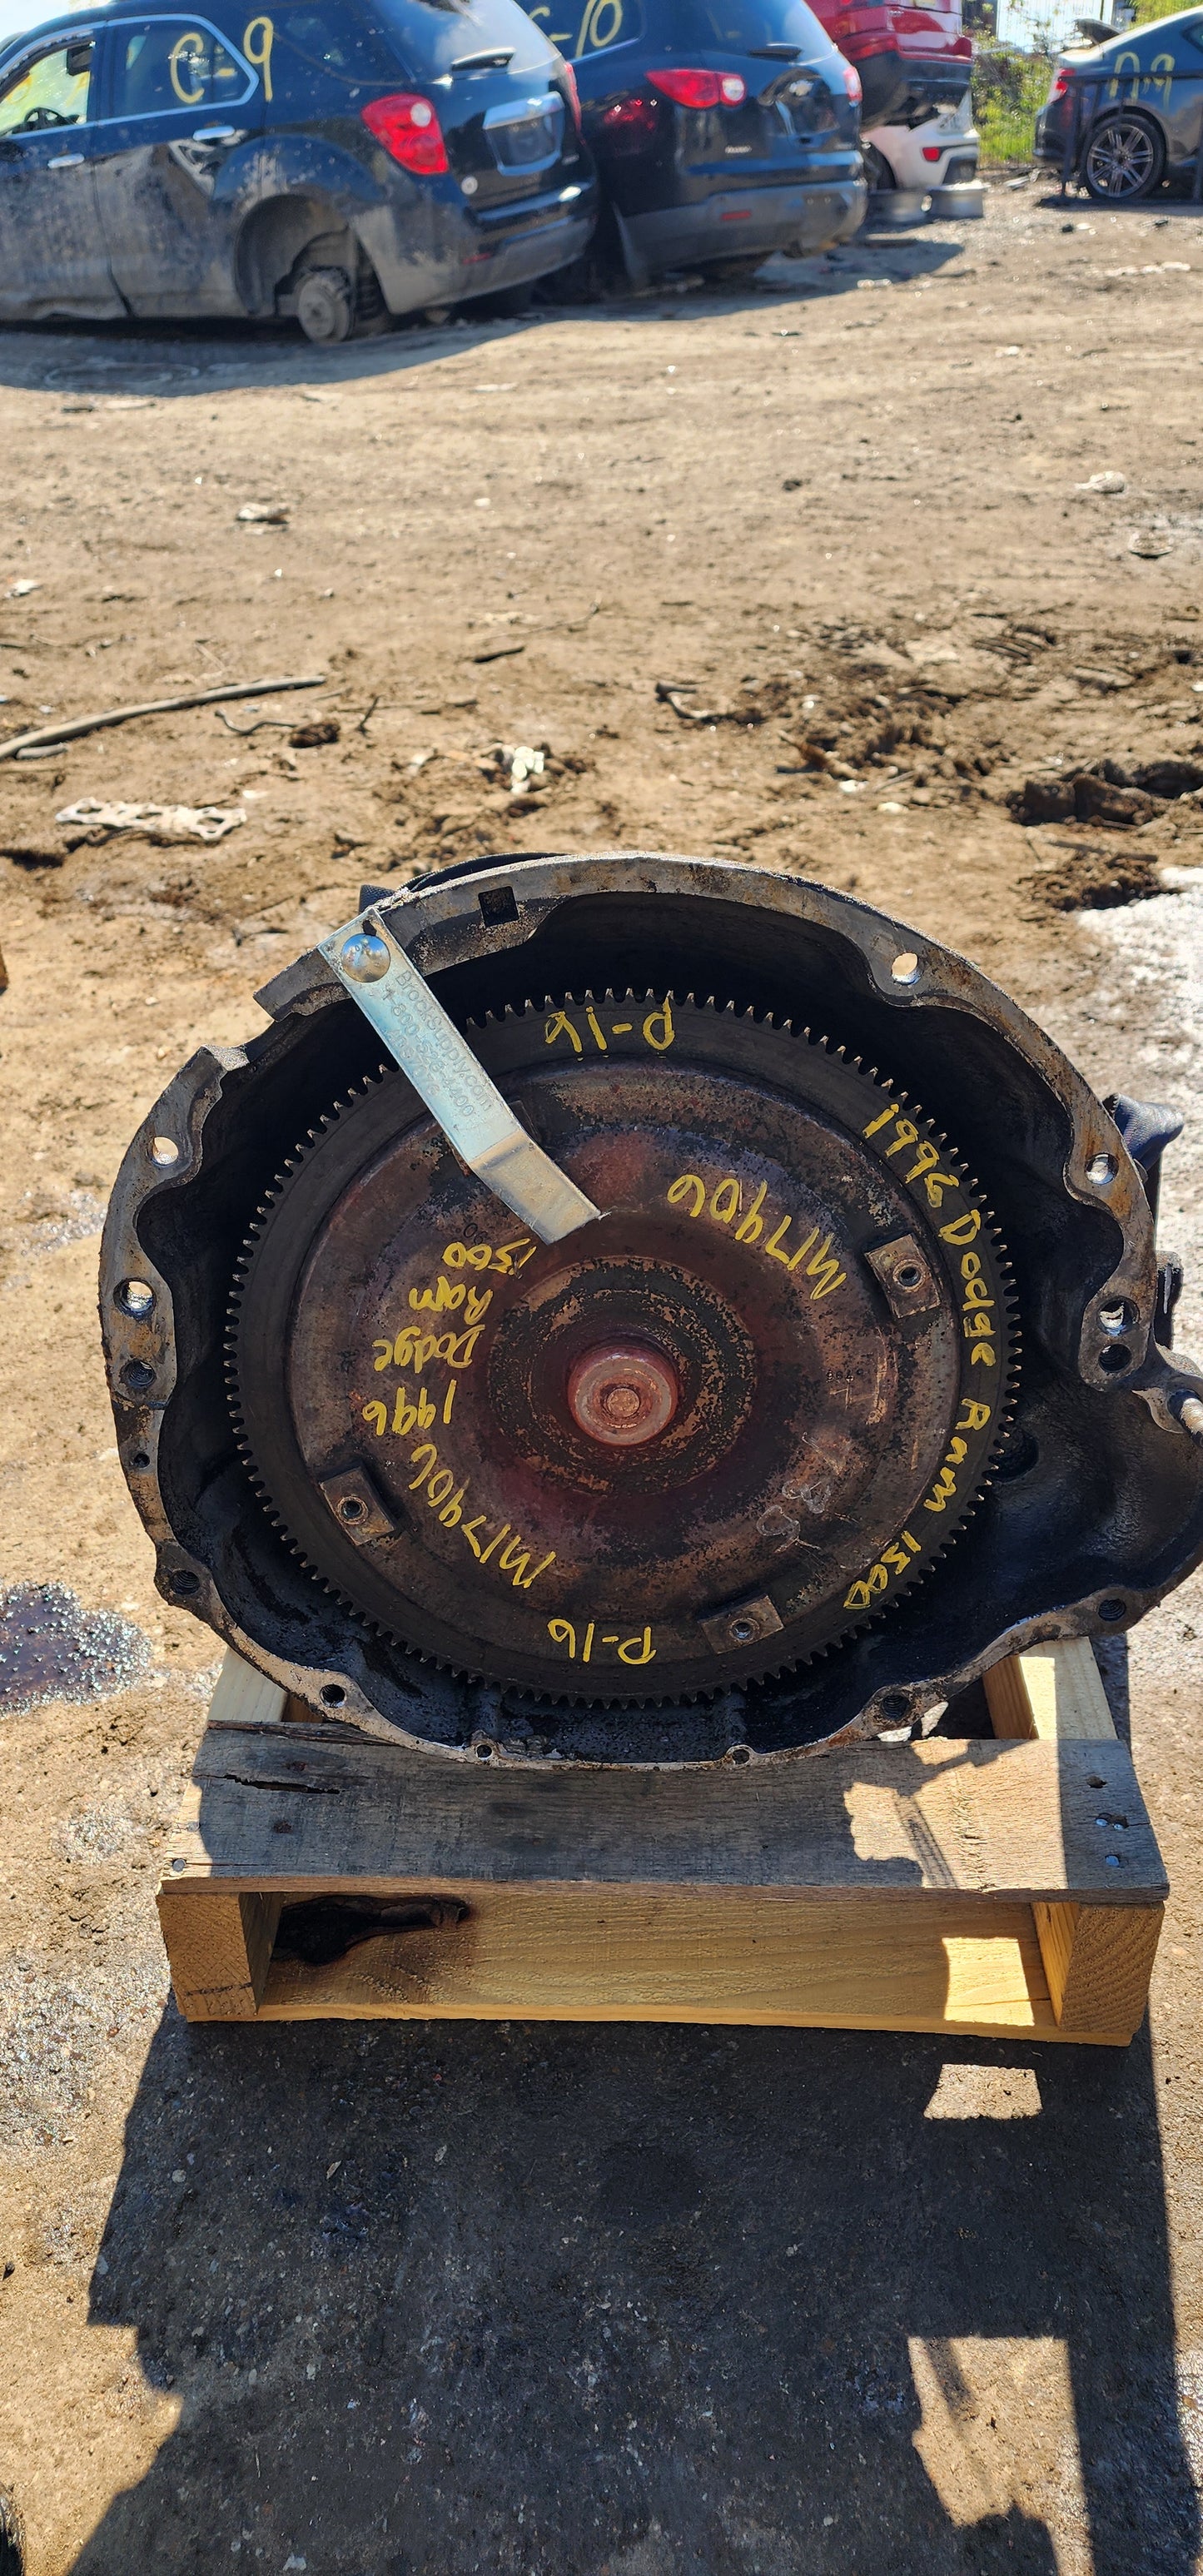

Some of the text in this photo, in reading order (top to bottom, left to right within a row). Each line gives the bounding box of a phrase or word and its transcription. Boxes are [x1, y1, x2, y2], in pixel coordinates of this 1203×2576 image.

[170, 16, 274, 103] C-9
[861, 1102, 960, 1209] 1996
[408, 1275, 494, 1327] Ram
[938, 1208, 997, 1368] Dodge
[373, 1325, 486, 1374] Dodge
[362, 1379, 457, 1436] 1996
[922, 1397, 992, 1513] Ram
[547, 1618, 658, 1666] P-16
